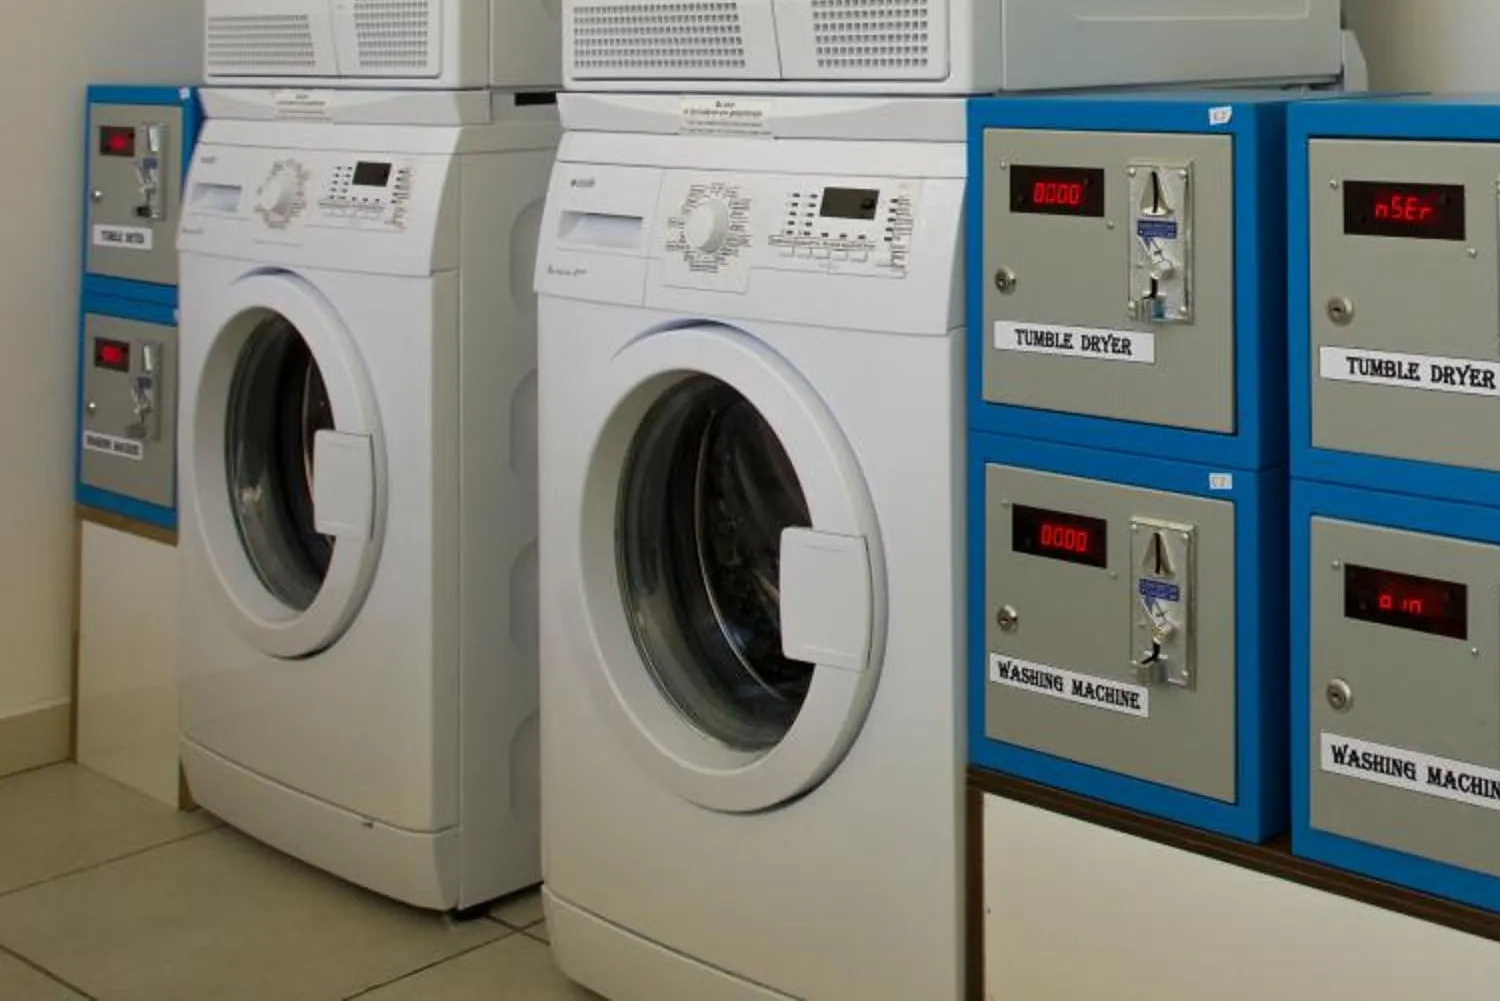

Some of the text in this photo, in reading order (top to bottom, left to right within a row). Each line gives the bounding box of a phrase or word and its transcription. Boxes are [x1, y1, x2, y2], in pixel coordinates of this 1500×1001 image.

[1034, 182, 1083, 205] 0000
[1015, 329, 1133, 356] TUMBLE DRYER
[1346, 356, 1496, 390] TUMBLE DRYER
[1041, 524, 1088, 552] 0000
[997, 660, 1140, 710] WASHING MACHINE
[1331, 744, 1416, 781] WASHING
